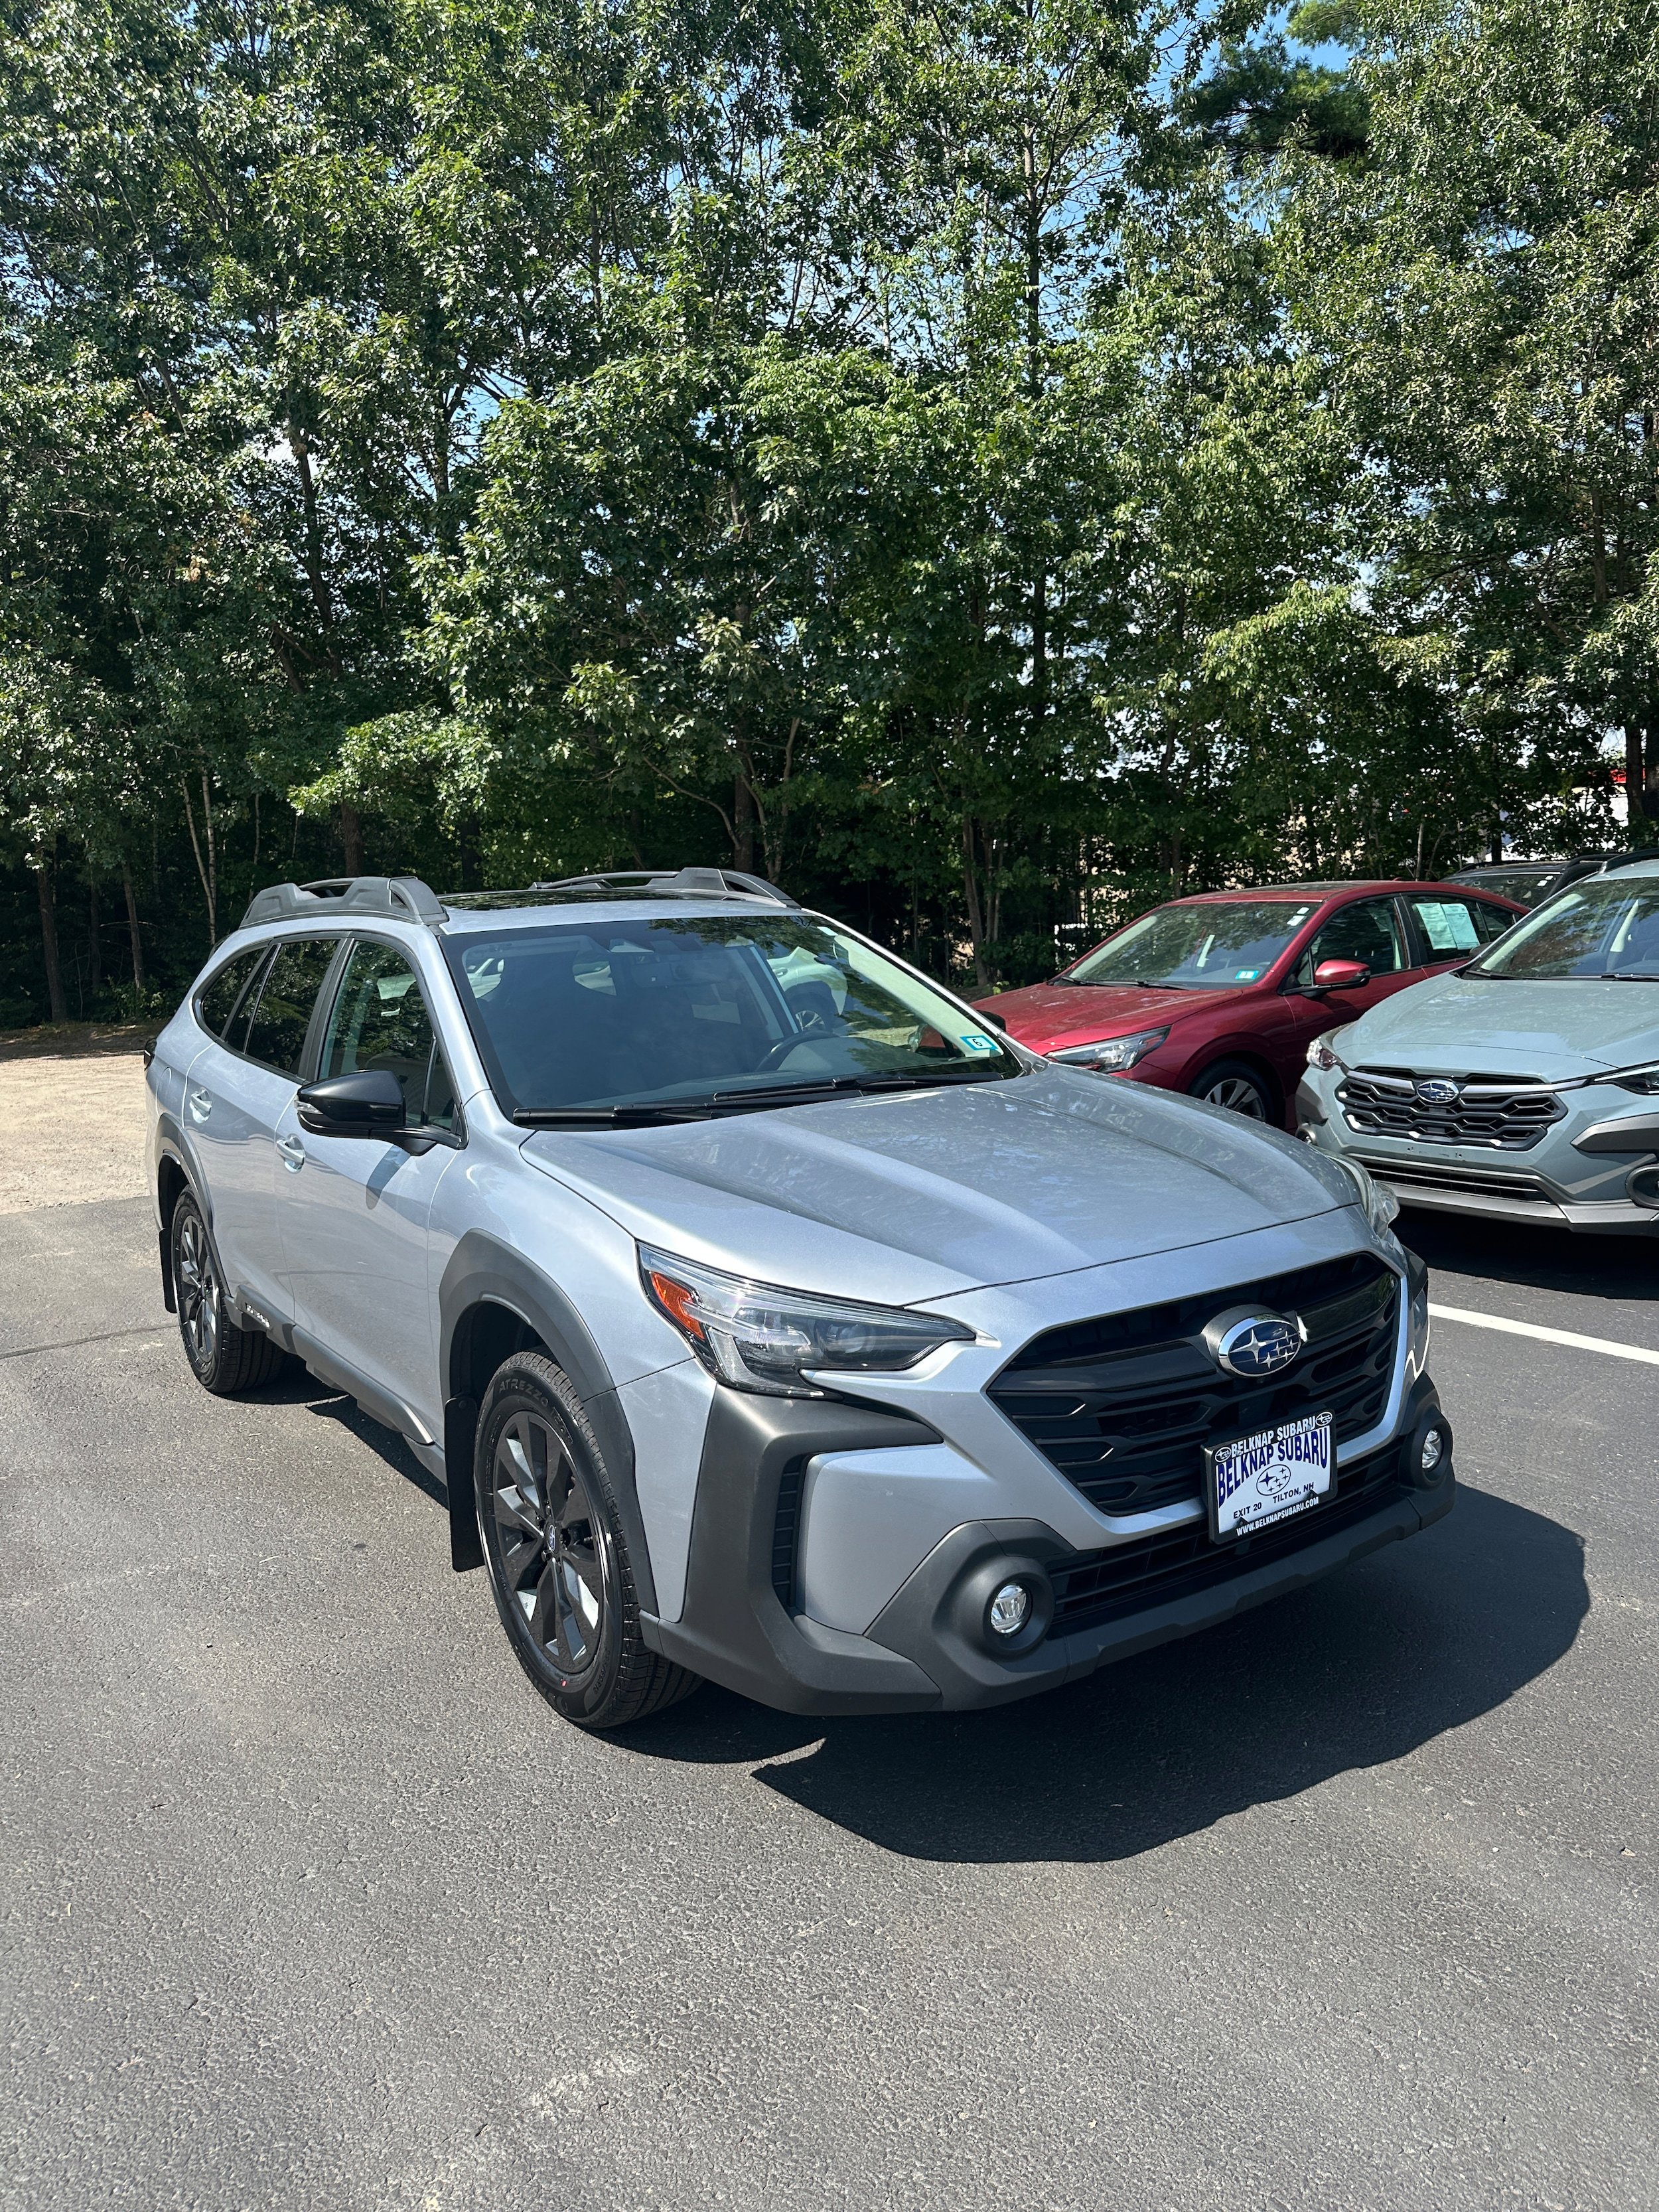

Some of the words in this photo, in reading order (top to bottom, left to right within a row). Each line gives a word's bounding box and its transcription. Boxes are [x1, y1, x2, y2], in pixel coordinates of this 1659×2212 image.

[499, 1378, 549, 1407] ATREZZO
[1231, 1430, 1274, 1458] BELKNAP
[1277, 1416, 1316, 1441] SUBARU
[1218, 1444, 1274, 1509] BELKNAP
[1277, 1428, 1328, 1469] SUBARU
[1233, 1506, 1251, 1519] EXIT
[1253, 1502, 1262, 1512] 20
[1273, 1487, 1301, 1504] TILTON,
[1303, 1482, 1314, 1493] NH
[1236, 1497, 1319, 1536] WWW.BELKNAPSUBARU.COM
